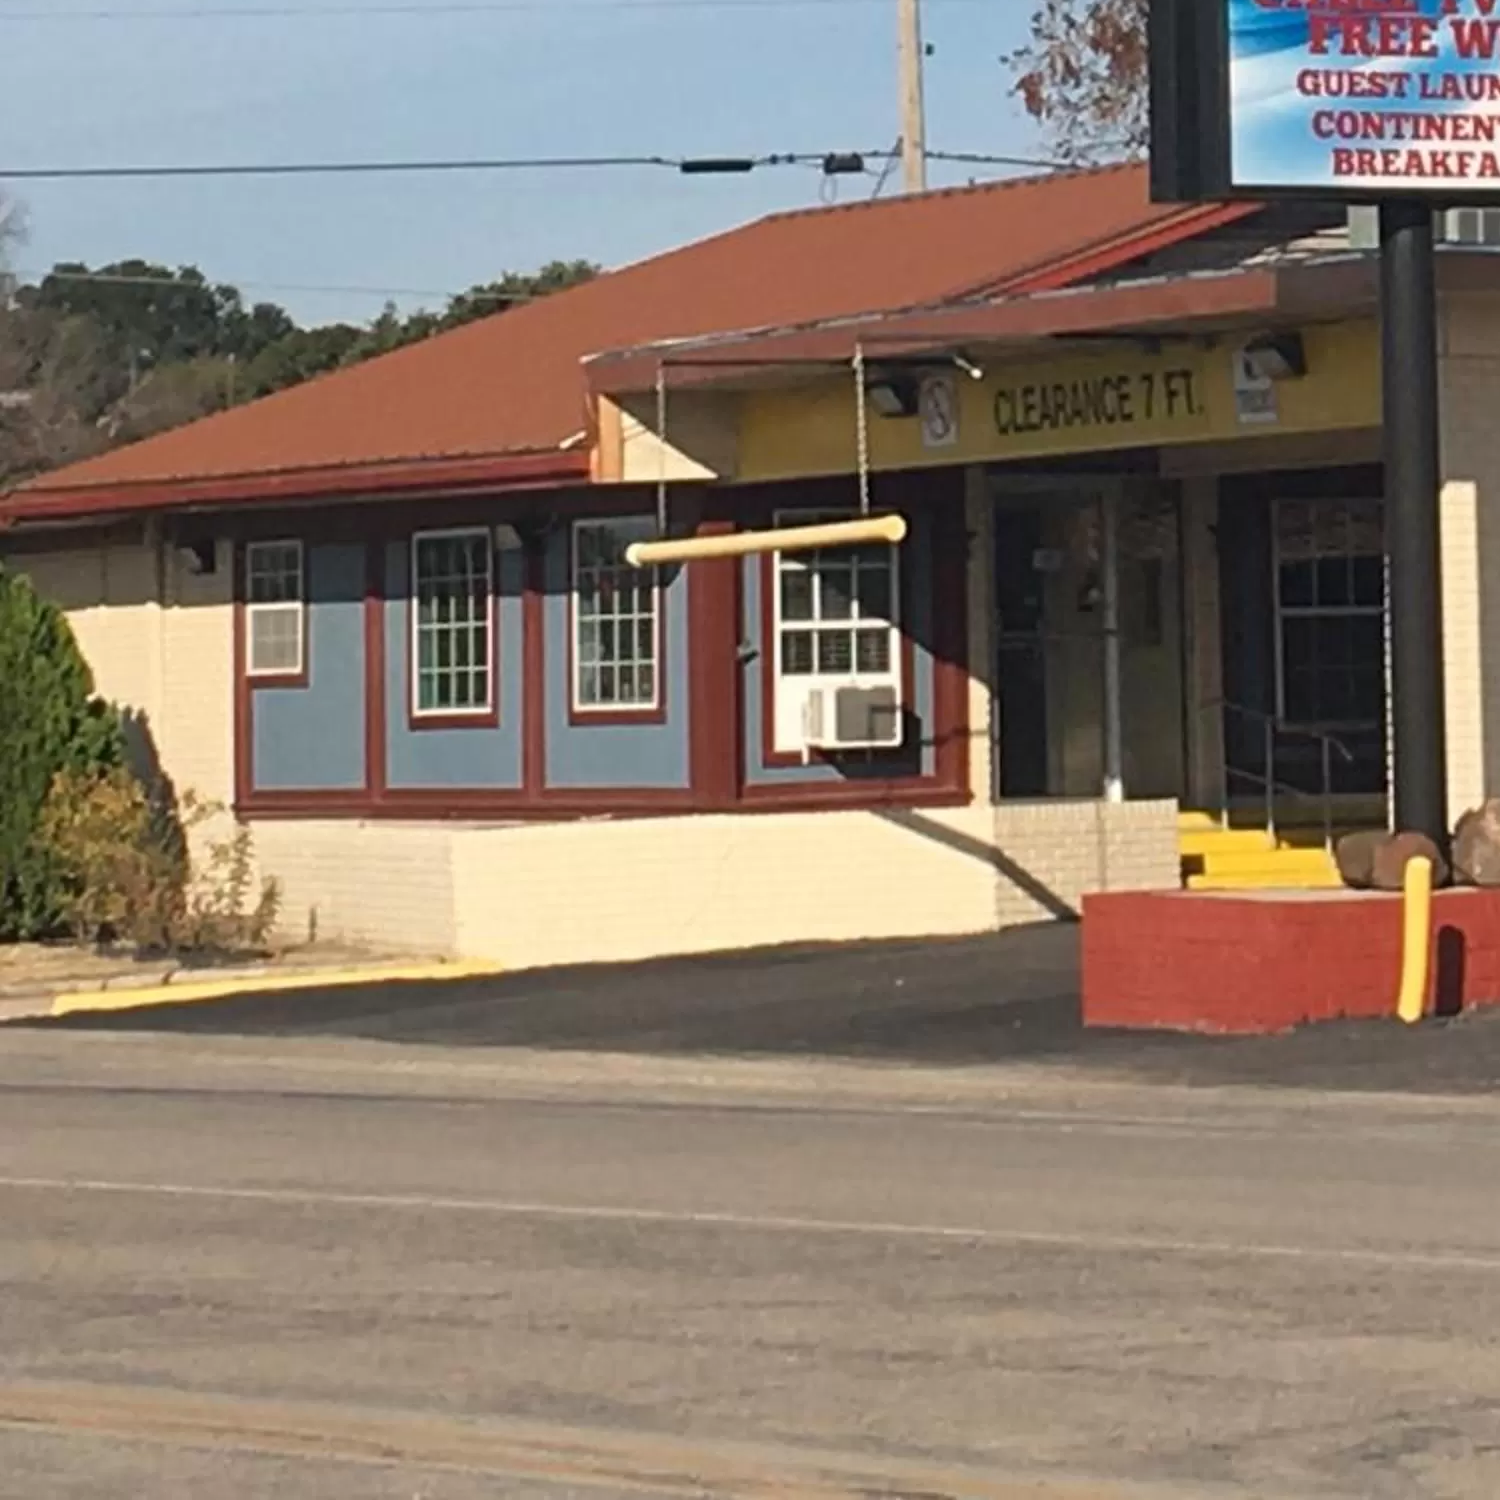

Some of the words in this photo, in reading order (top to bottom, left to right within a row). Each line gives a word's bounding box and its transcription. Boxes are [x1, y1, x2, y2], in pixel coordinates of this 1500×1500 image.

[1308, 16, 1438, 57] FREE
[1297, 69, 1413, 99] GUEST
[993, 375, 1133, 435] CLEARANCE
[1140, 373, 1154, 420] 7
[1163, 370, 1205, 418] FT.
